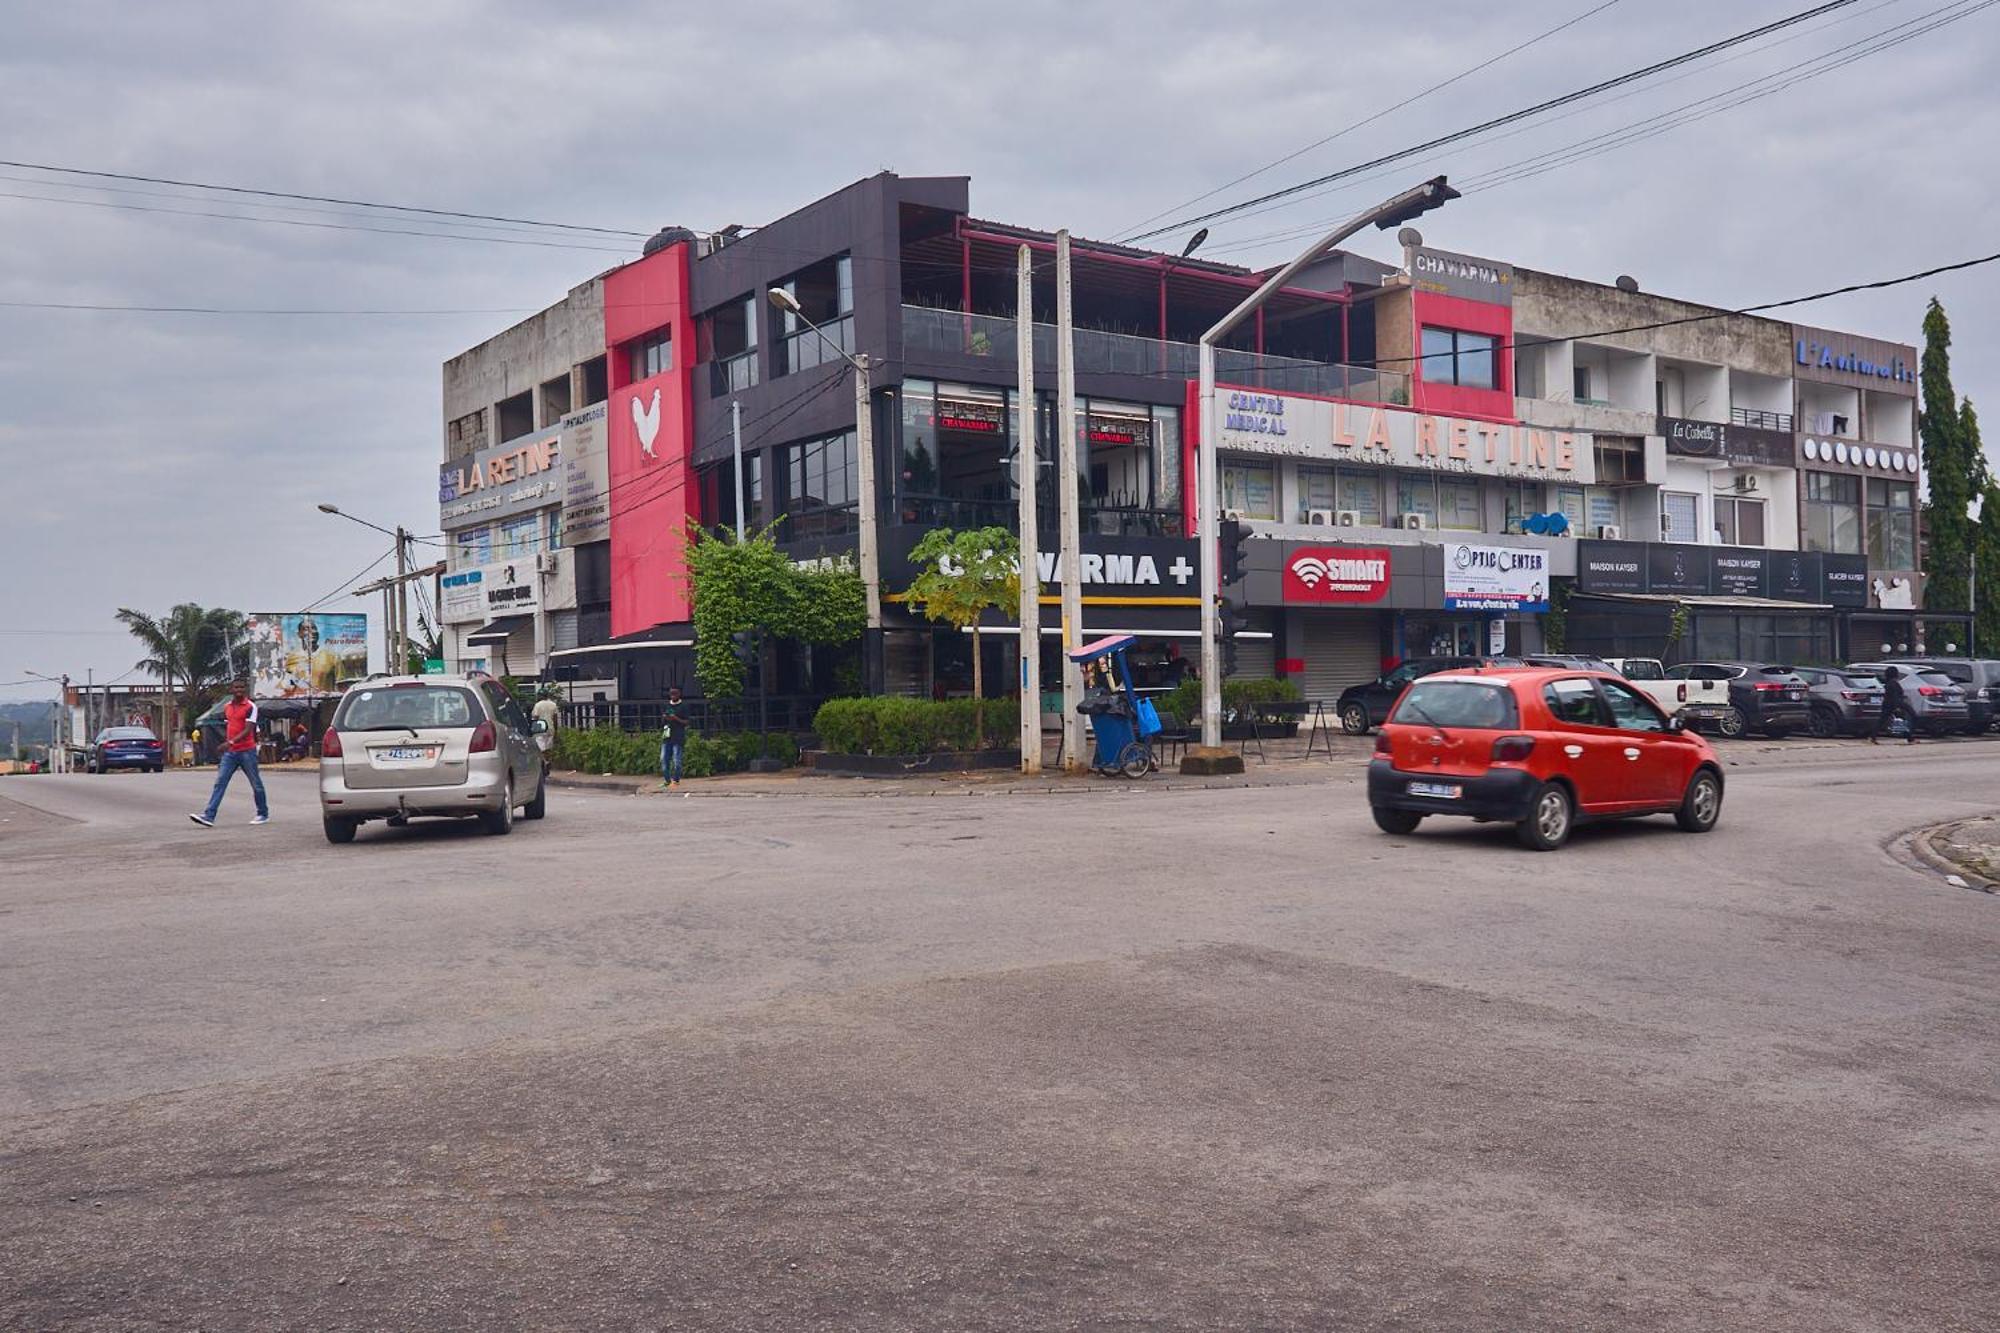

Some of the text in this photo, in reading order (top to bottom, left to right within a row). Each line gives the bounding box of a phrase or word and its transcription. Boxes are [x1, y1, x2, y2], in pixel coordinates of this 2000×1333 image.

[1417, 254, 1499, 284] CHAWARMA
[1228, 393, 1284, 416] CENTRE
[1226, 414, 1287, 436] MEDICAL
[1673, 422, 1683, 437] La
[1333, 405, 1575, 471] LA RETINE
[457, 463, 485, 497] LA
[938, 550, 1160, 584] CWRMA
[1455, 545, 1543, 573] OPTIC CENTER
[1590, 561, 1638, 573] MAISON KAYSER
[1717, 558, 1761, 569] MAISON KAYSER
